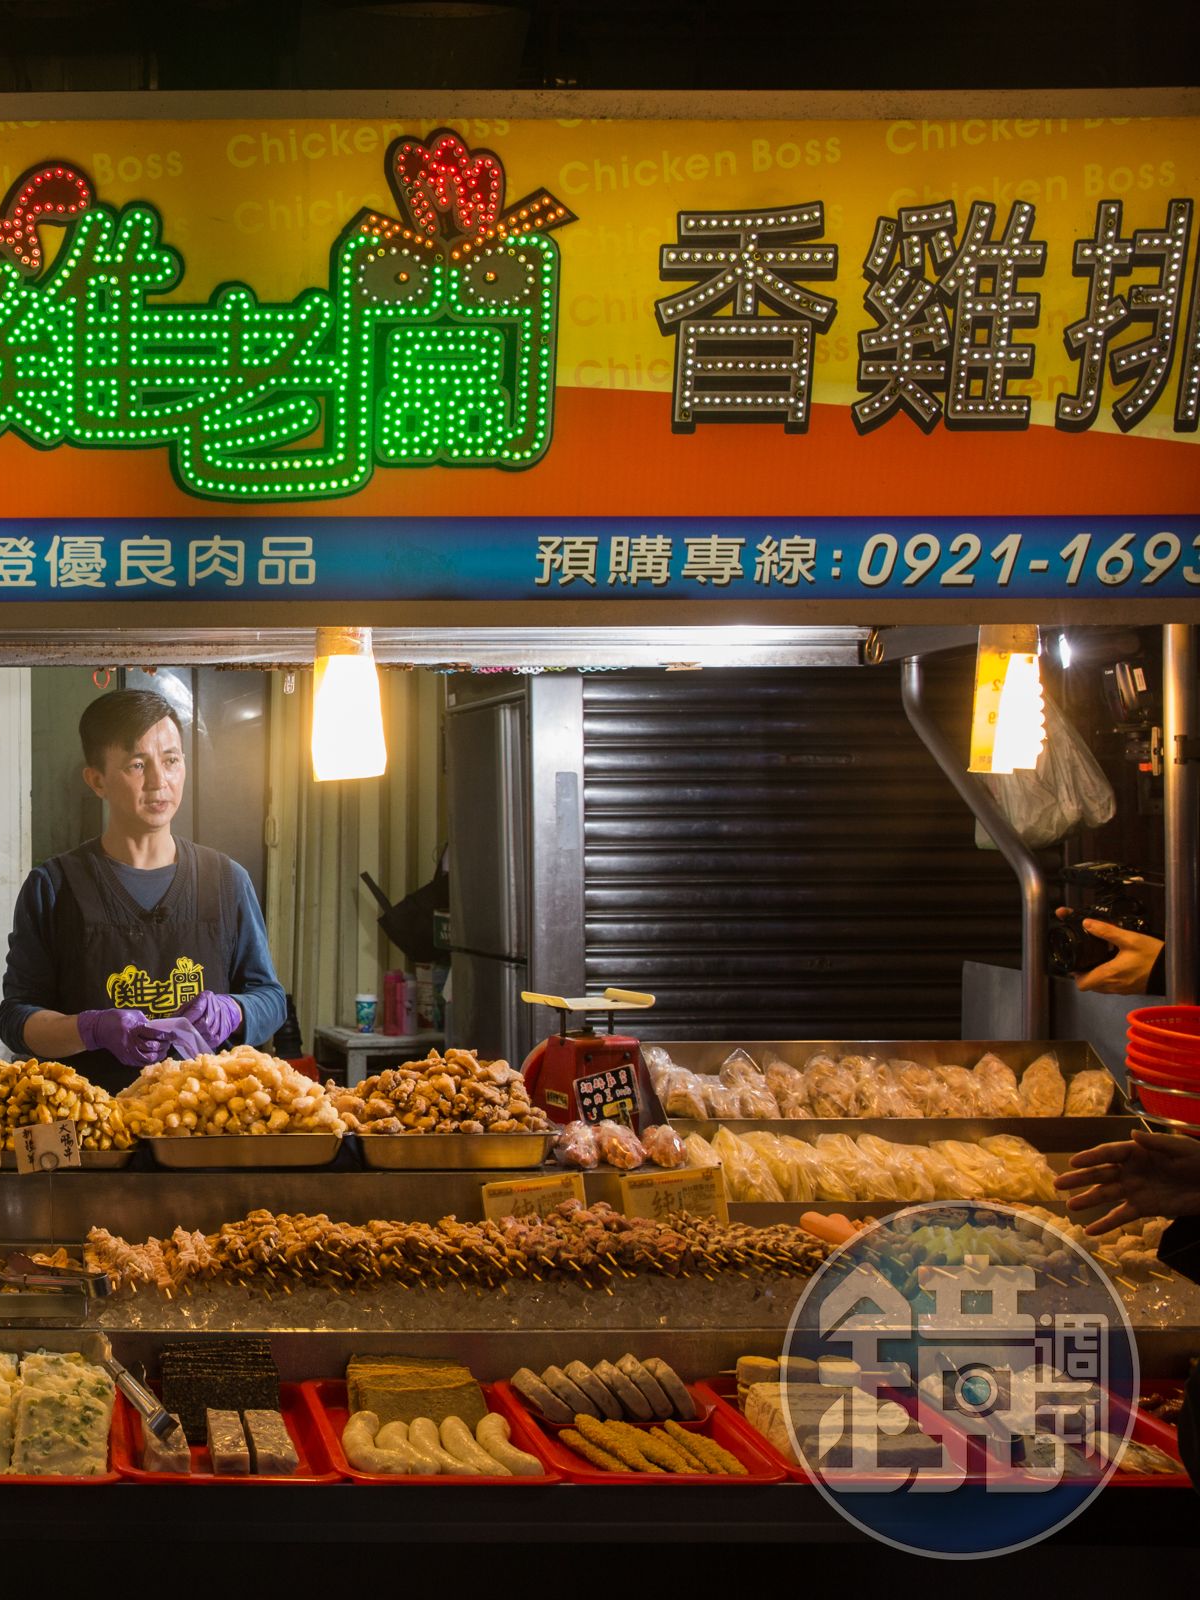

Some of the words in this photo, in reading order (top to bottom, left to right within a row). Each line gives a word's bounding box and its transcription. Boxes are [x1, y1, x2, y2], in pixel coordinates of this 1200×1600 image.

[92, 149, 184, 186] Boss
[558, 150, 737, 195] Chicken
[751, 136, 842, 173] Boss
[1083, 160, 1176, 197] Boss
